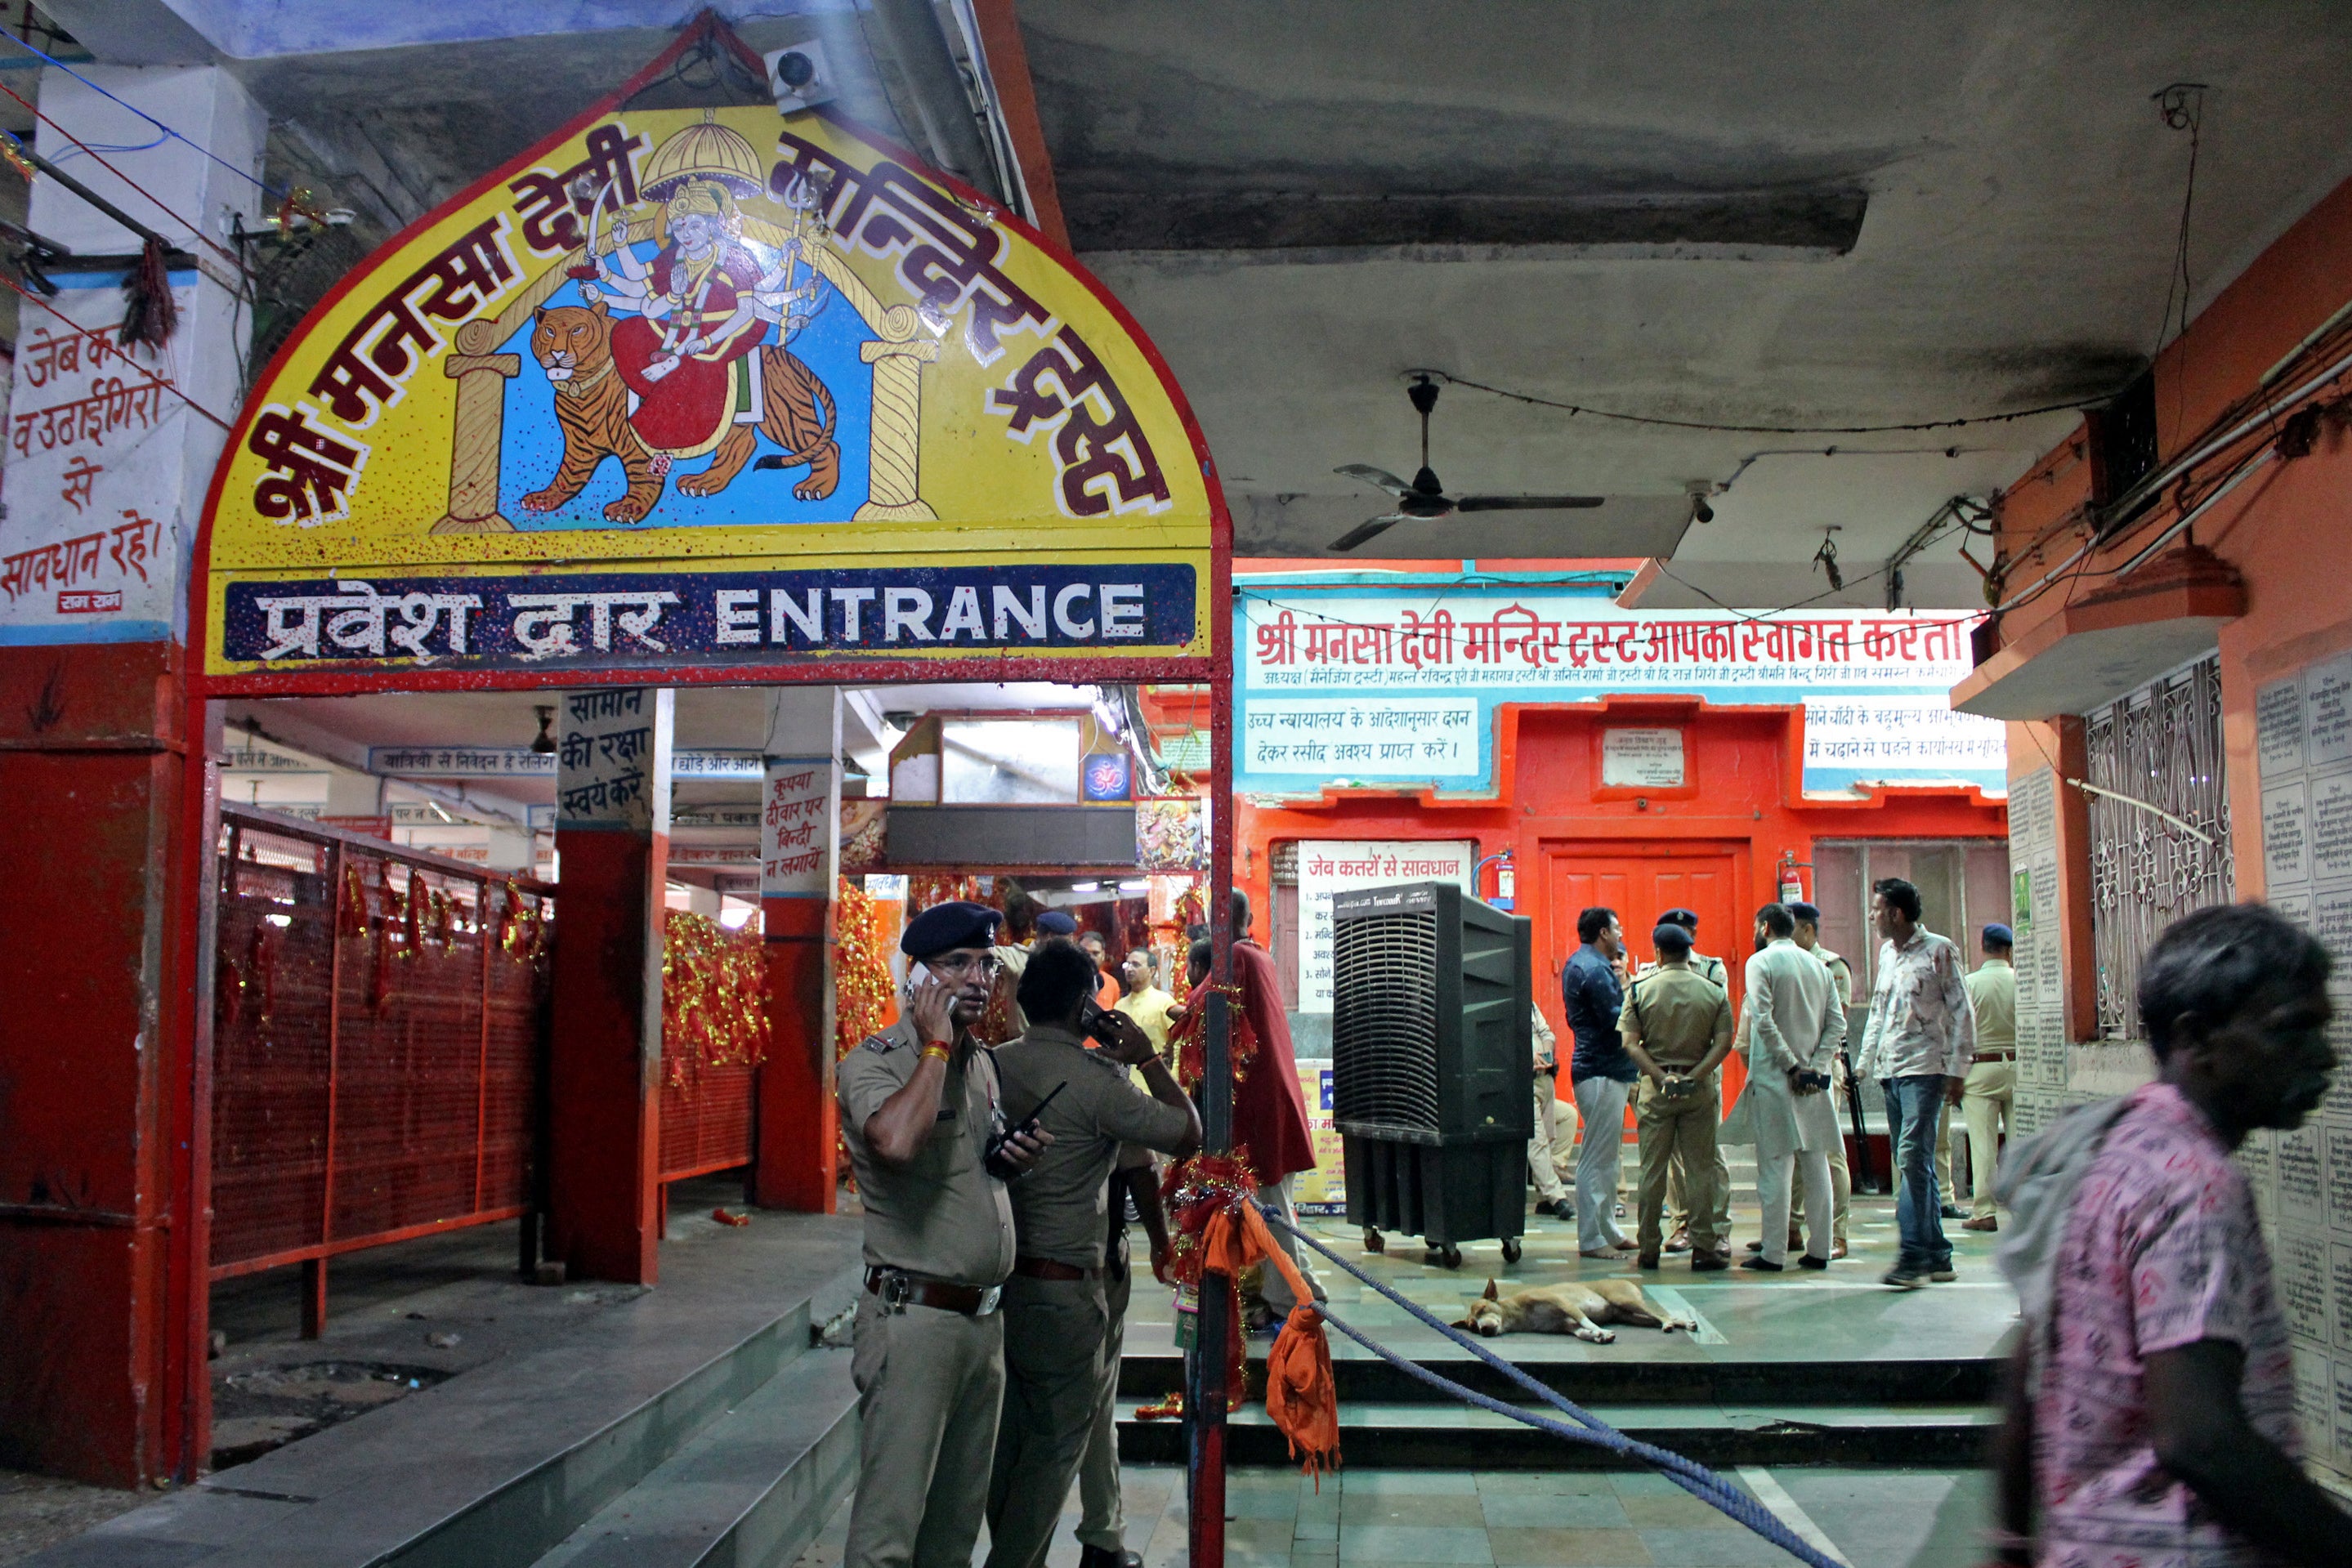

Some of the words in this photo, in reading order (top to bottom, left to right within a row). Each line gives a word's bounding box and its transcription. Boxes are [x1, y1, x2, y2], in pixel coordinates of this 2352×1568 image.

[508, 121, 653, 259] देवी
[307, 212, 525, 429] मनसा
[25, 328, 83, 387] जेब
[13, 414, 38, 458] व
[983, 323, 1172, 520] ट्रस्ट
[61, 456, 104, 513] से
[248, 404, 370, 528] श्री
[2, 532, 106, 602] सावधान
[255, 579, 484, 666] प्रवेश
[716, 583, 1144, 644] ENTRANCE
[1257, 610, 1298, 664] श्री
[1303, 623, 1394, 664] मनसा
[1401, 610, 1455, 670] देवी
[1460, 601, 1562, 668] मन्दिर
[1567, 622, 1639, 668] ट्रस्ट
[1642, 621, 1739, 663] आपका
[1742, 619, 1853, 663] स्वागत
[1860, 619, 1965, 662] करता
[568, 688, 643, 724] सामान
[1350, 707, 1366, 729] के
[1858, 704, 1869, 725] के
[561, 731, 595, 771] की
[598, 726, 651, 766] रक्षा
[1257, 739, 1289, 763] देकर
[1292, 739, 1329, 763] रसीद
[1334, 744, 1373, 763] अवश्य
[1379, 743, 1415, 761] प्राप्त
[1422, 737, 1447, 760] करें
[1863, 737, 1876, 757] से
[774, 771, 815, 801] कृपया
[804, 796, 826, 816] पर
[766, 860, 778, 878] न
[1308, 854, 1334, 877] जेब
[1339, 854, 1382, 878] कतरों
[1384, 855, 1397, 877] से
[1402, 859, 1460, 877] सावधान
